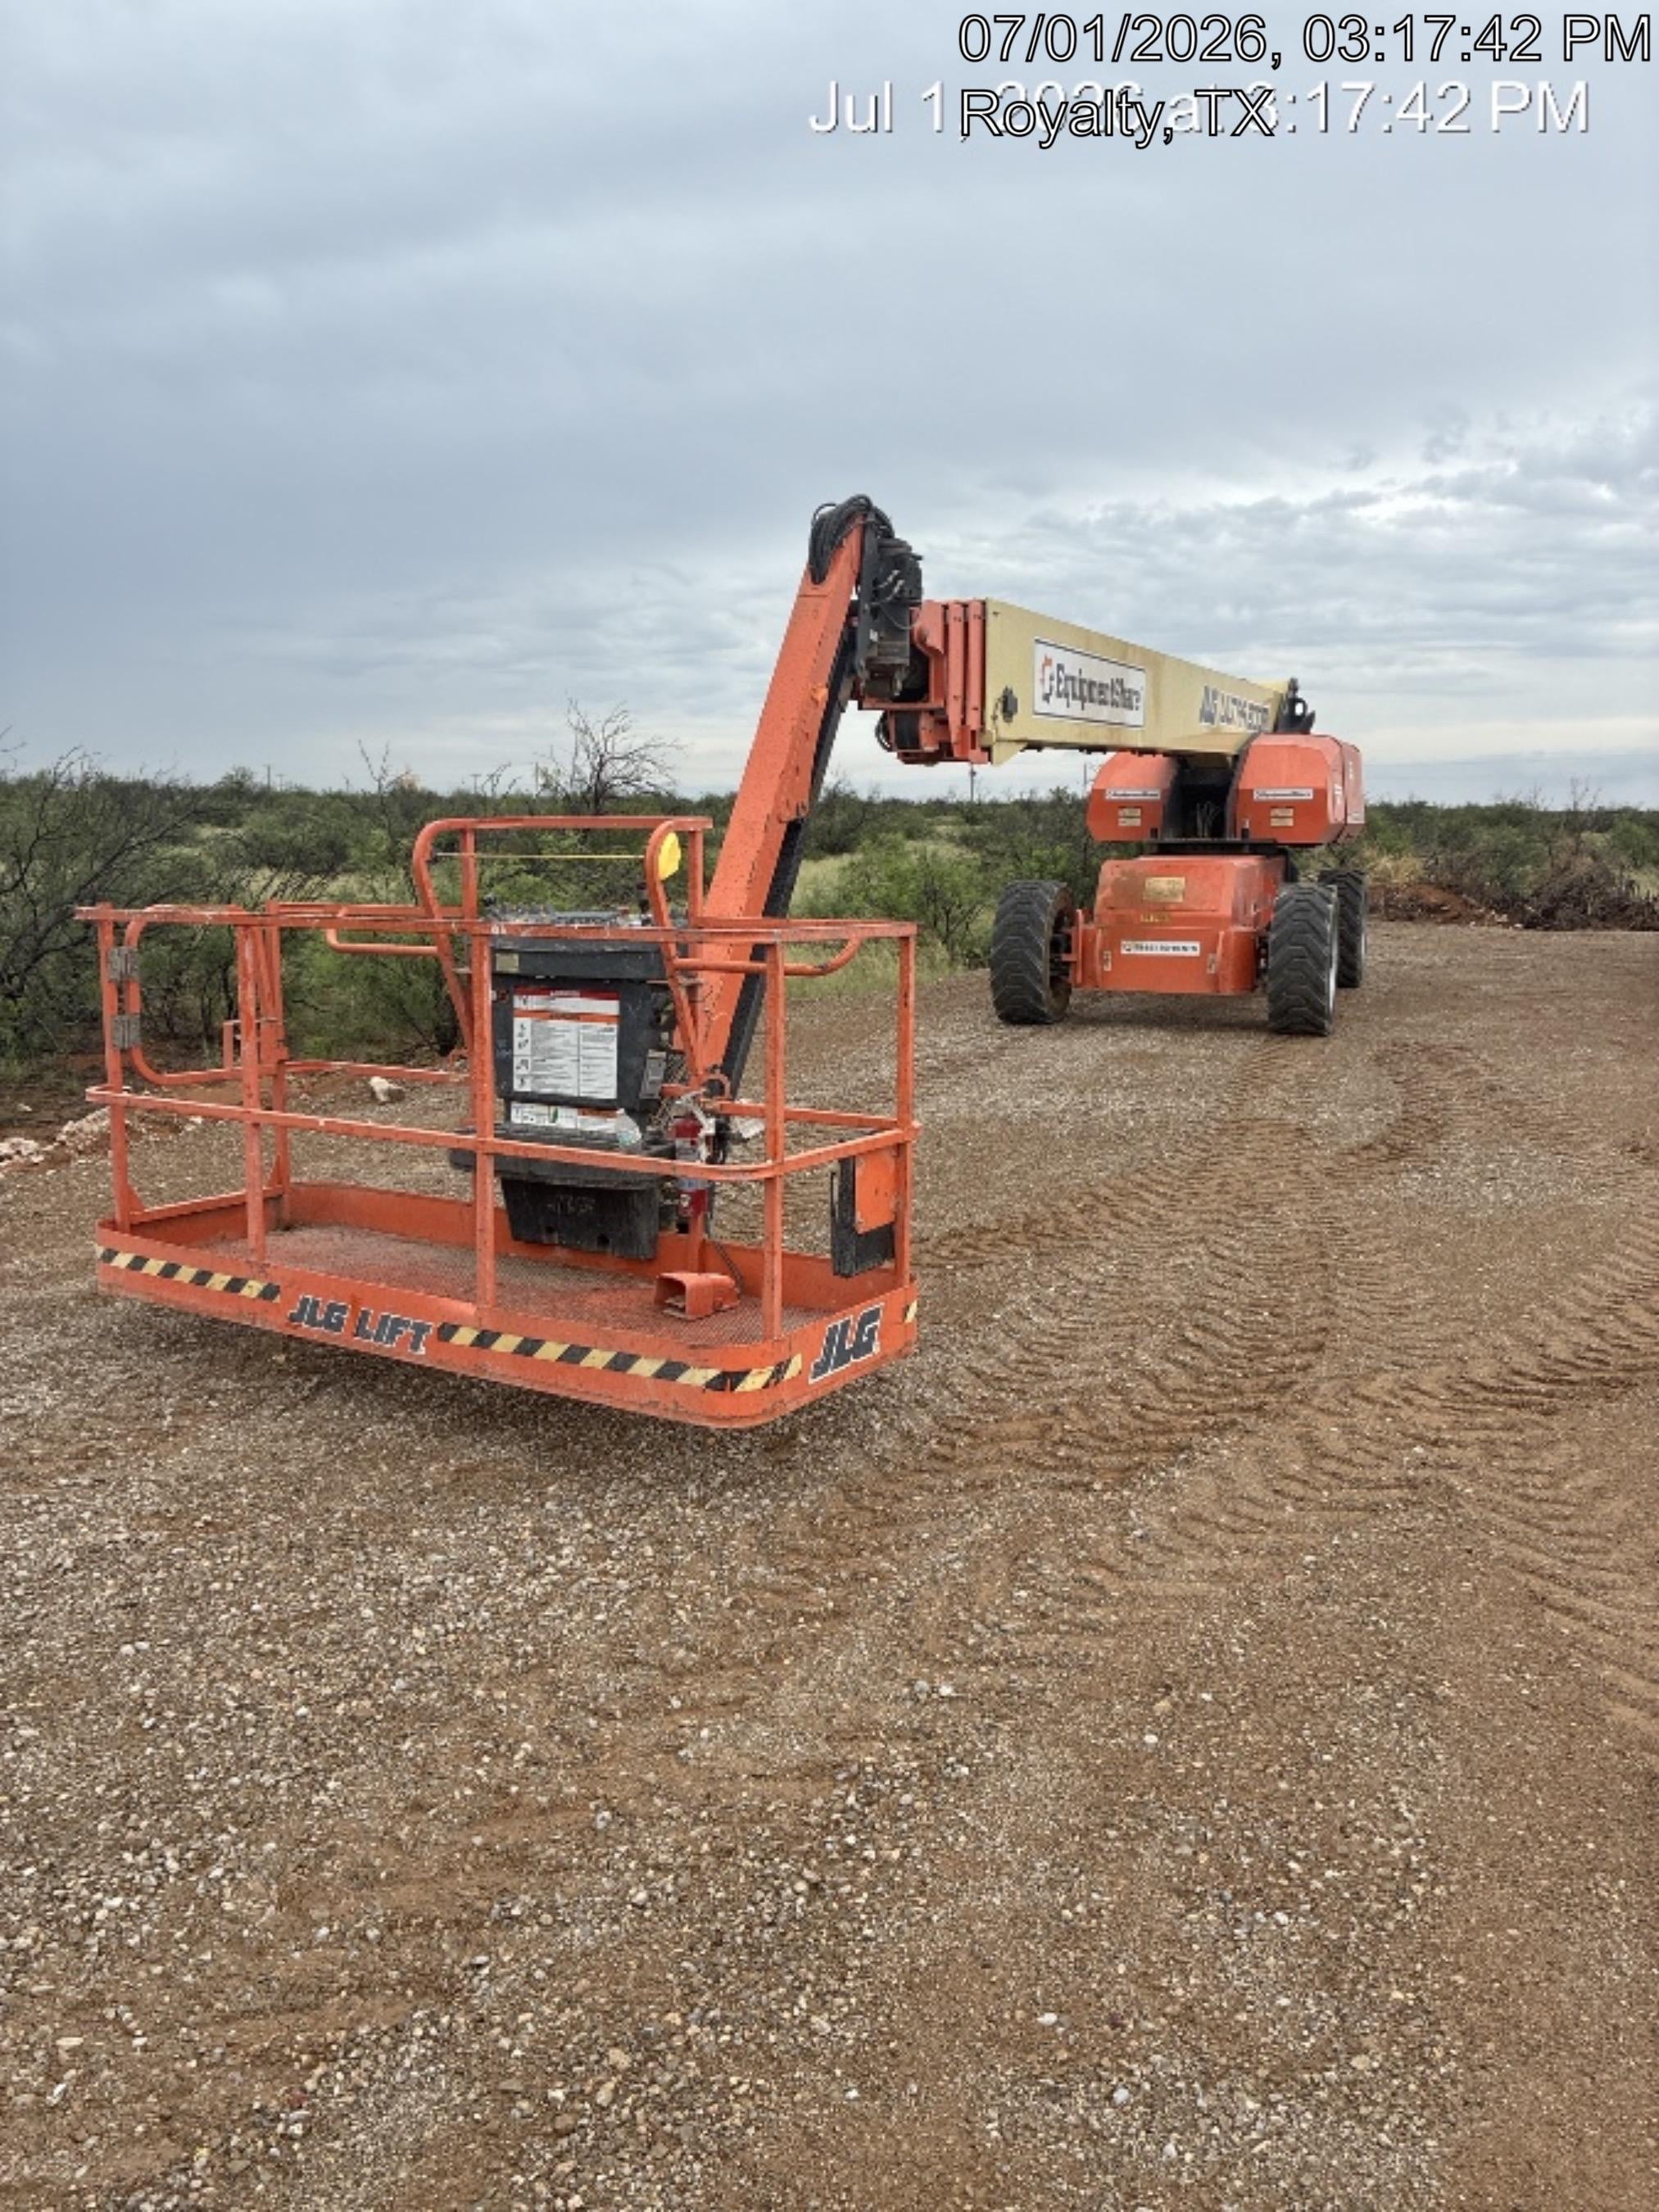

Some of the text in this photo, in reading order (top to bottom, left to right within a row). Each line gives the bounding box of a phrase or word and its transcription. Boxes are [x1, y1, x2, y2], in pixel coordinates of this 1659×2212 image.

[288, 1294, 434, 1355] JLG LIFT
[808, 1303, 885, 1385] JLG
